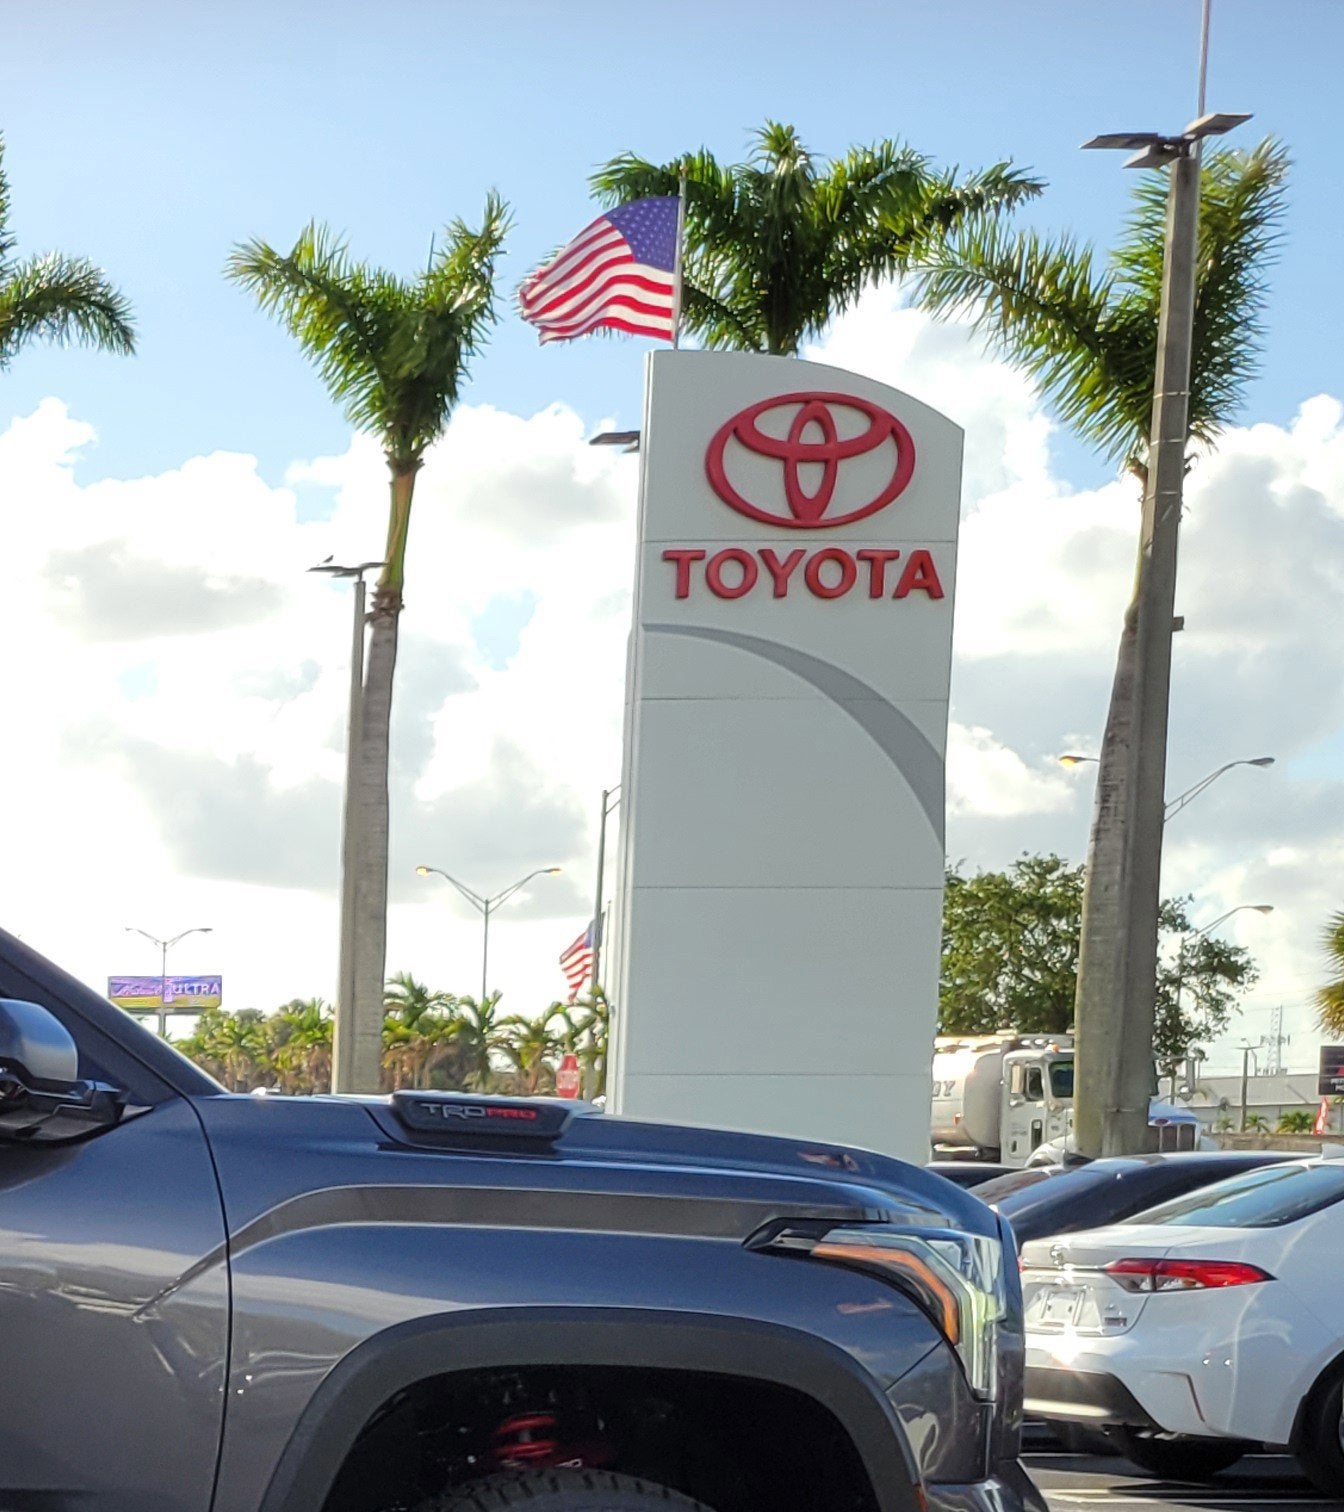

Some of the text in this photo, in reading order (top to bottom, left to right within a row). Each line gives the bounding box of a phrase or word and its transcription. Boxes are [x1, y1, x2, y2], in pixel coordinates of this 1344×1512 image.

[663, 547, 944, 600] TOYOTA
[173, 983, 220, 995] ULTRA
[420, 1103, 537, 1120] TRD PRO
